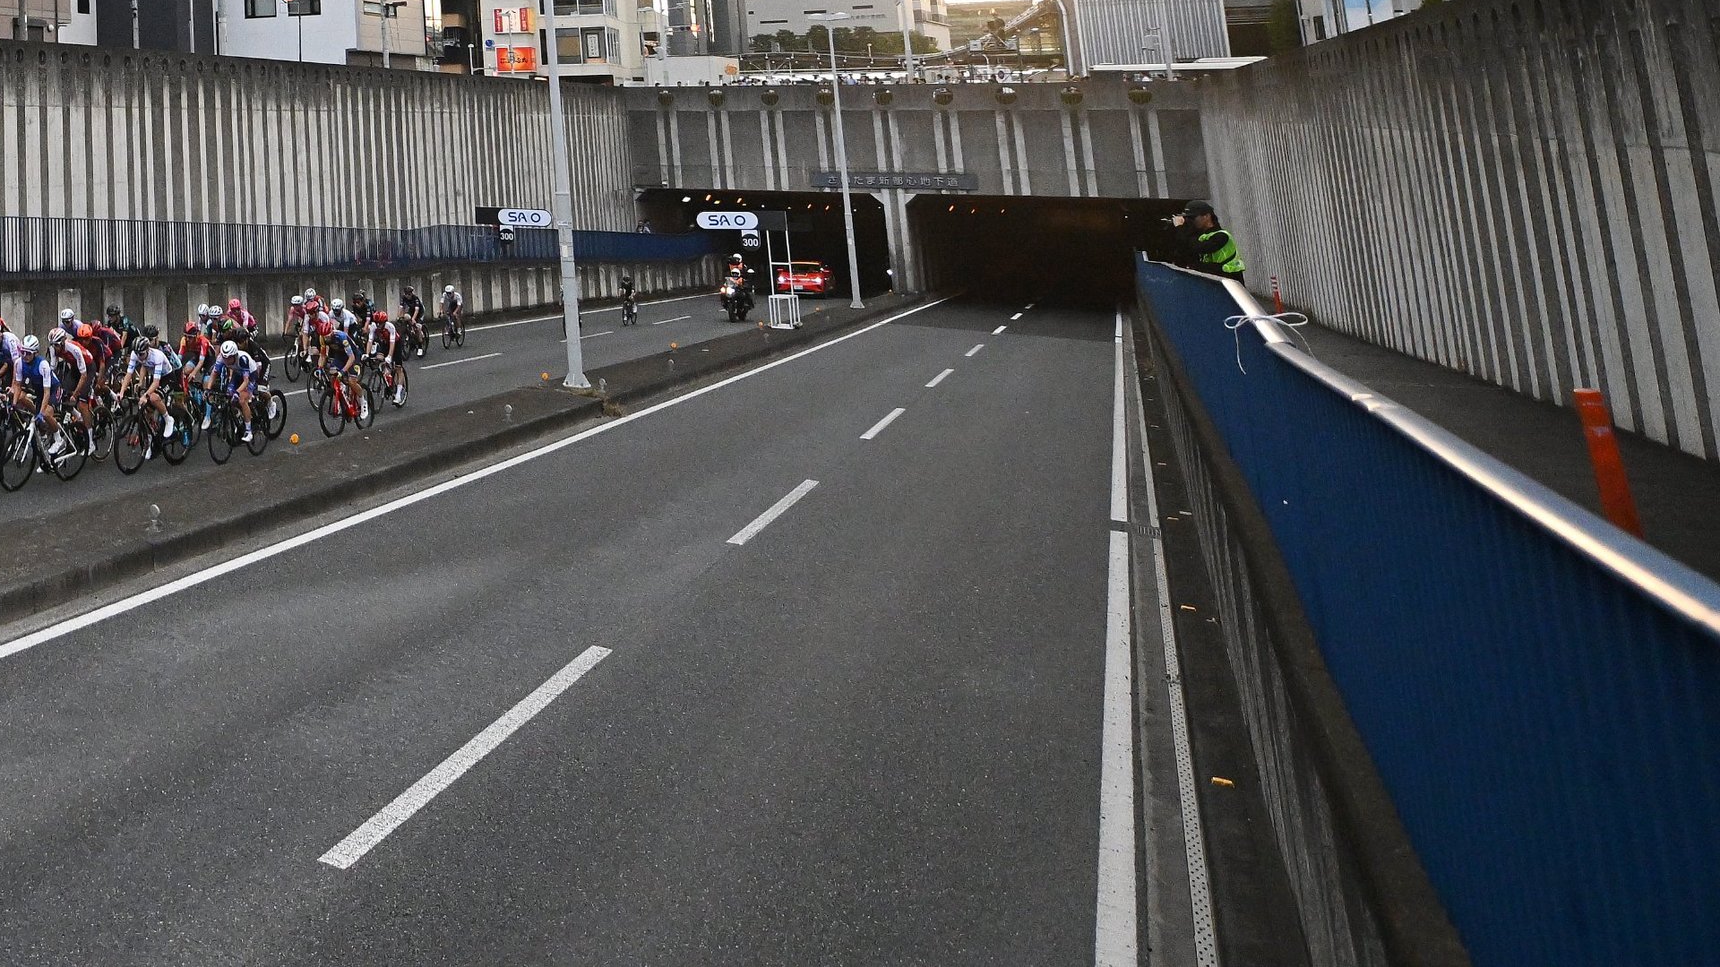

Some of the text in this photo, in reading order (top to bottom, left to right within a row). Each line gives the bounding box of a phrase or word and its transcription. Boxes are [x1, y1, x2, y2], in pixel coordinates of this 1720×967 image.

[828, 175, 958, 186] さたま新都心地下道
[500, 232, 514, 241] 300
[742, 238, 759, 247] 300
